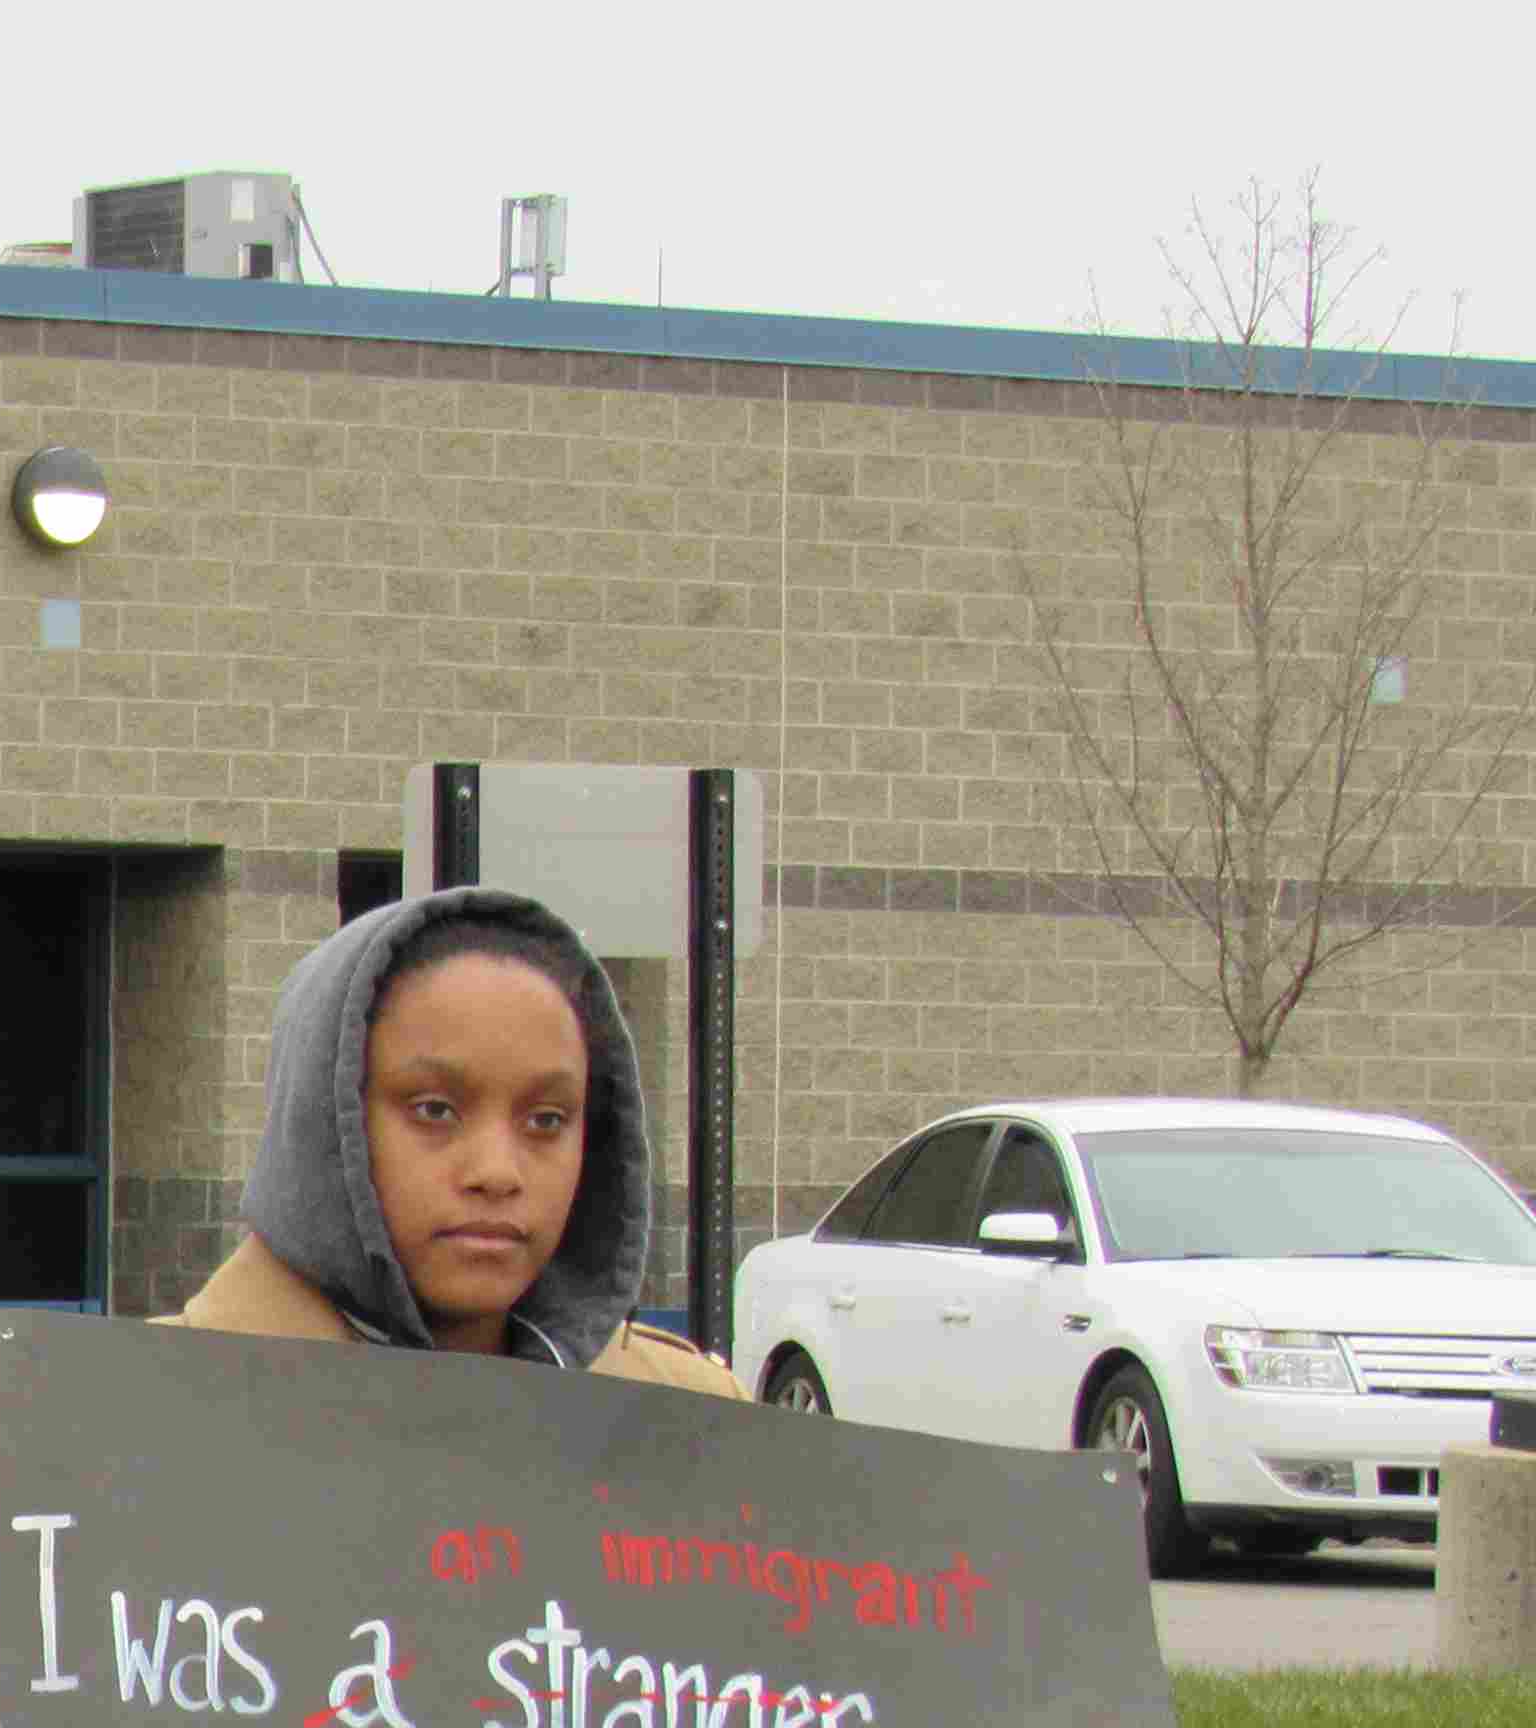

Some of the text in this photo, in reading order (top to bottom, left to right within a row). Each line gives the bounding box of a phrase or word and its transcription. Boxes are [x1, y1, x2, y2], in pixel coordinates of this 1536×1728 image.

[11, 1513, 77, 1693] I
[111, 1589, 276, 1716] was
[430, 1484, 991, 1635] an immigrant
